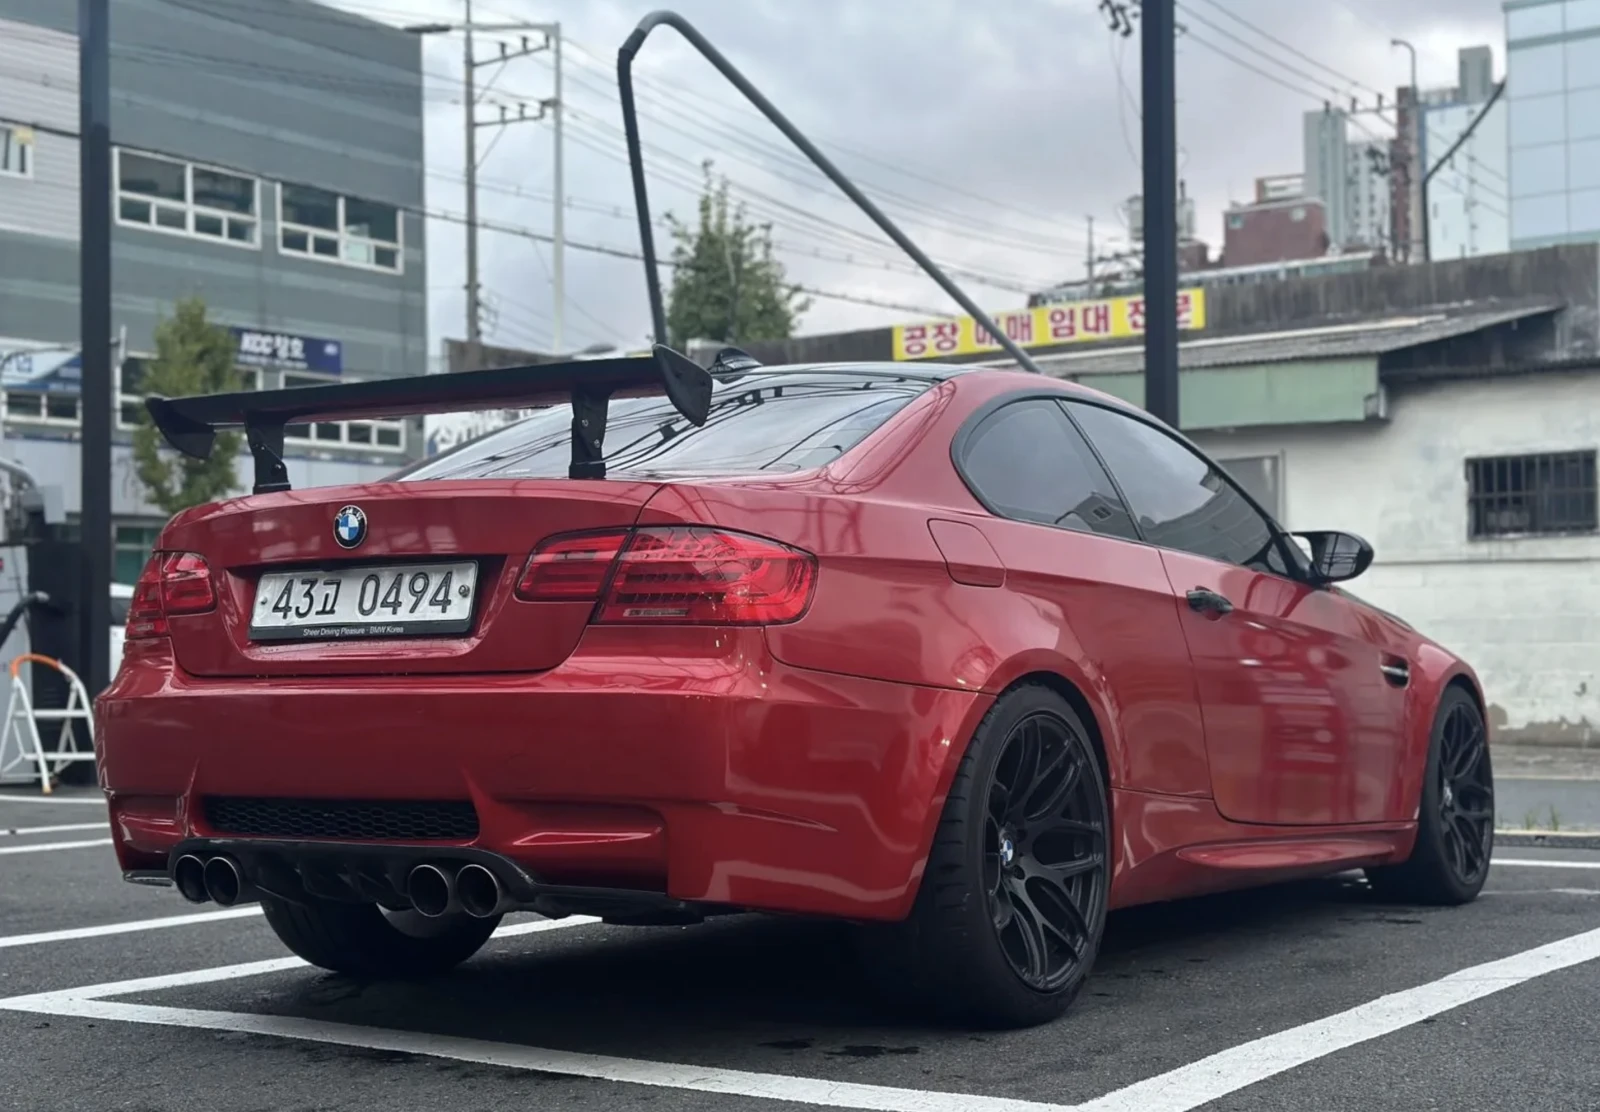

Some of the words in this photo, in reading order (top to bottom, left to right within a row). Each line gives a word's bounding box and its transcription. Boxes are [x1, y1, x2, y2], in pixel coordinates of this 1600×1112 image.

[905, 323, 958, 355] 공장
[1050, 304, 1109, 338] 임대
[271, 578, 342, 619] 43고
[358, 572, 453, 616] 0494
[303, 628, 320, 636] Sheer
[321, 628, 340, 637] Driving
[341, 627, 365, 635] Pleasure
[370, 626, 386, 634] BMW
[386, 625, 404, 633] Korea
